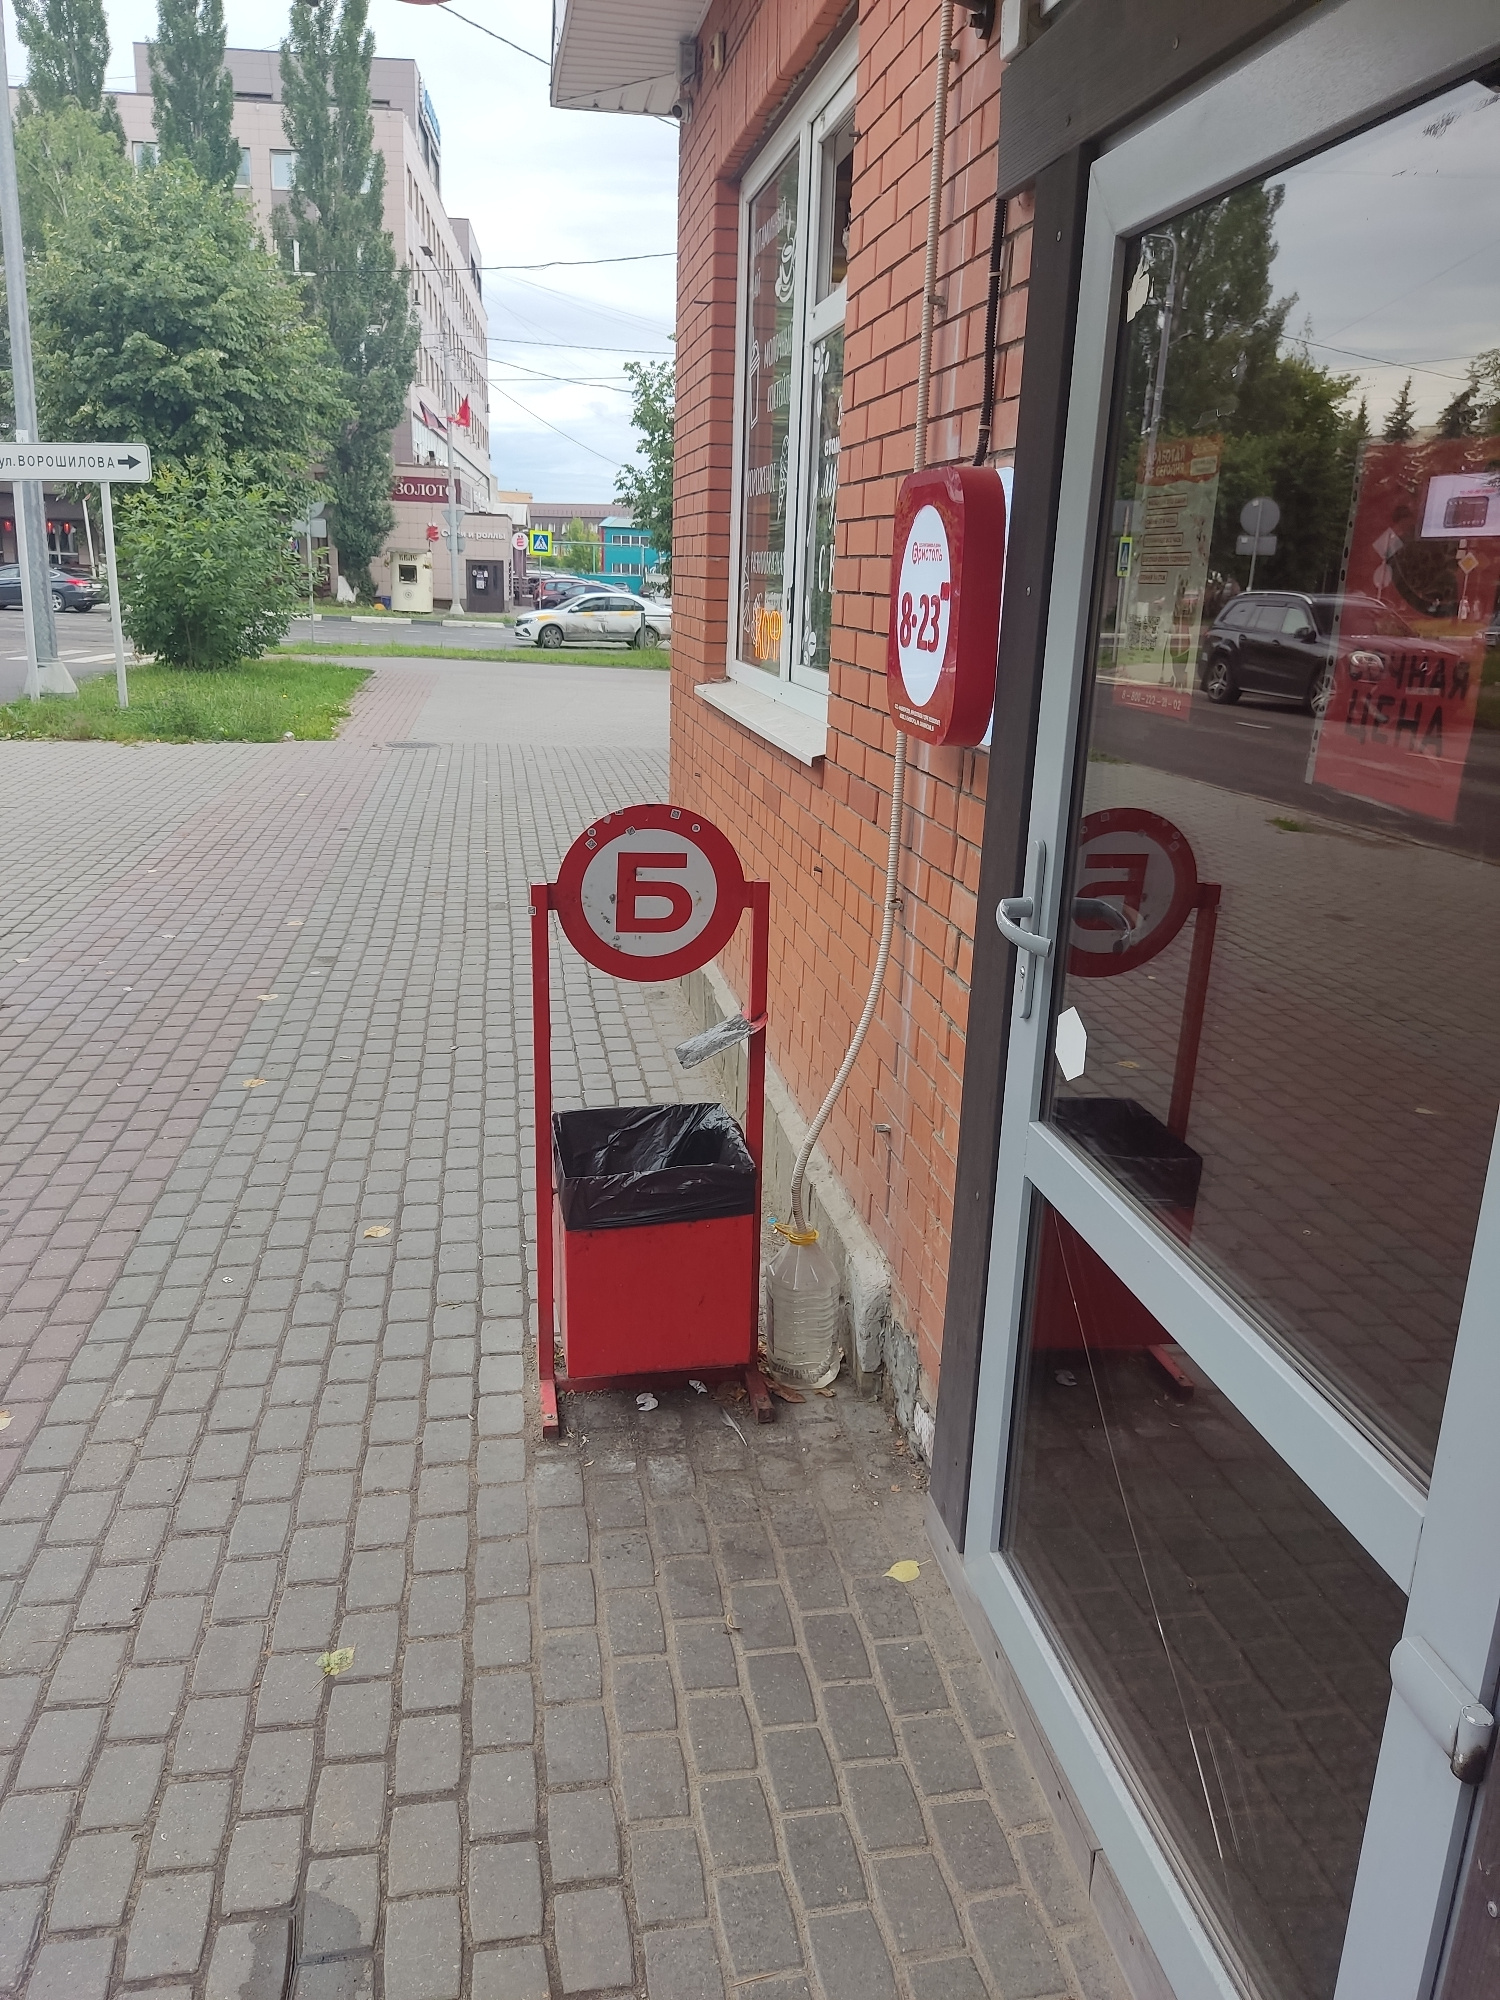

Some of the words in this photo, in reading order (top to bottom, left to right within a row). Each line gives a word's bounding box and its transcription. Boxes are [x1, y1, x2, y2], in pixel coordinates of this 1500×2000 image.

[0, 457, 16, 470] ул.
[18, 455, 115, 469] ВОРОШИЛОВА
[755, 605, 783, 662] КОФ
[1344, 688, 1443, 758] ЦЕНА
[616, 852, 692, 933] Б
